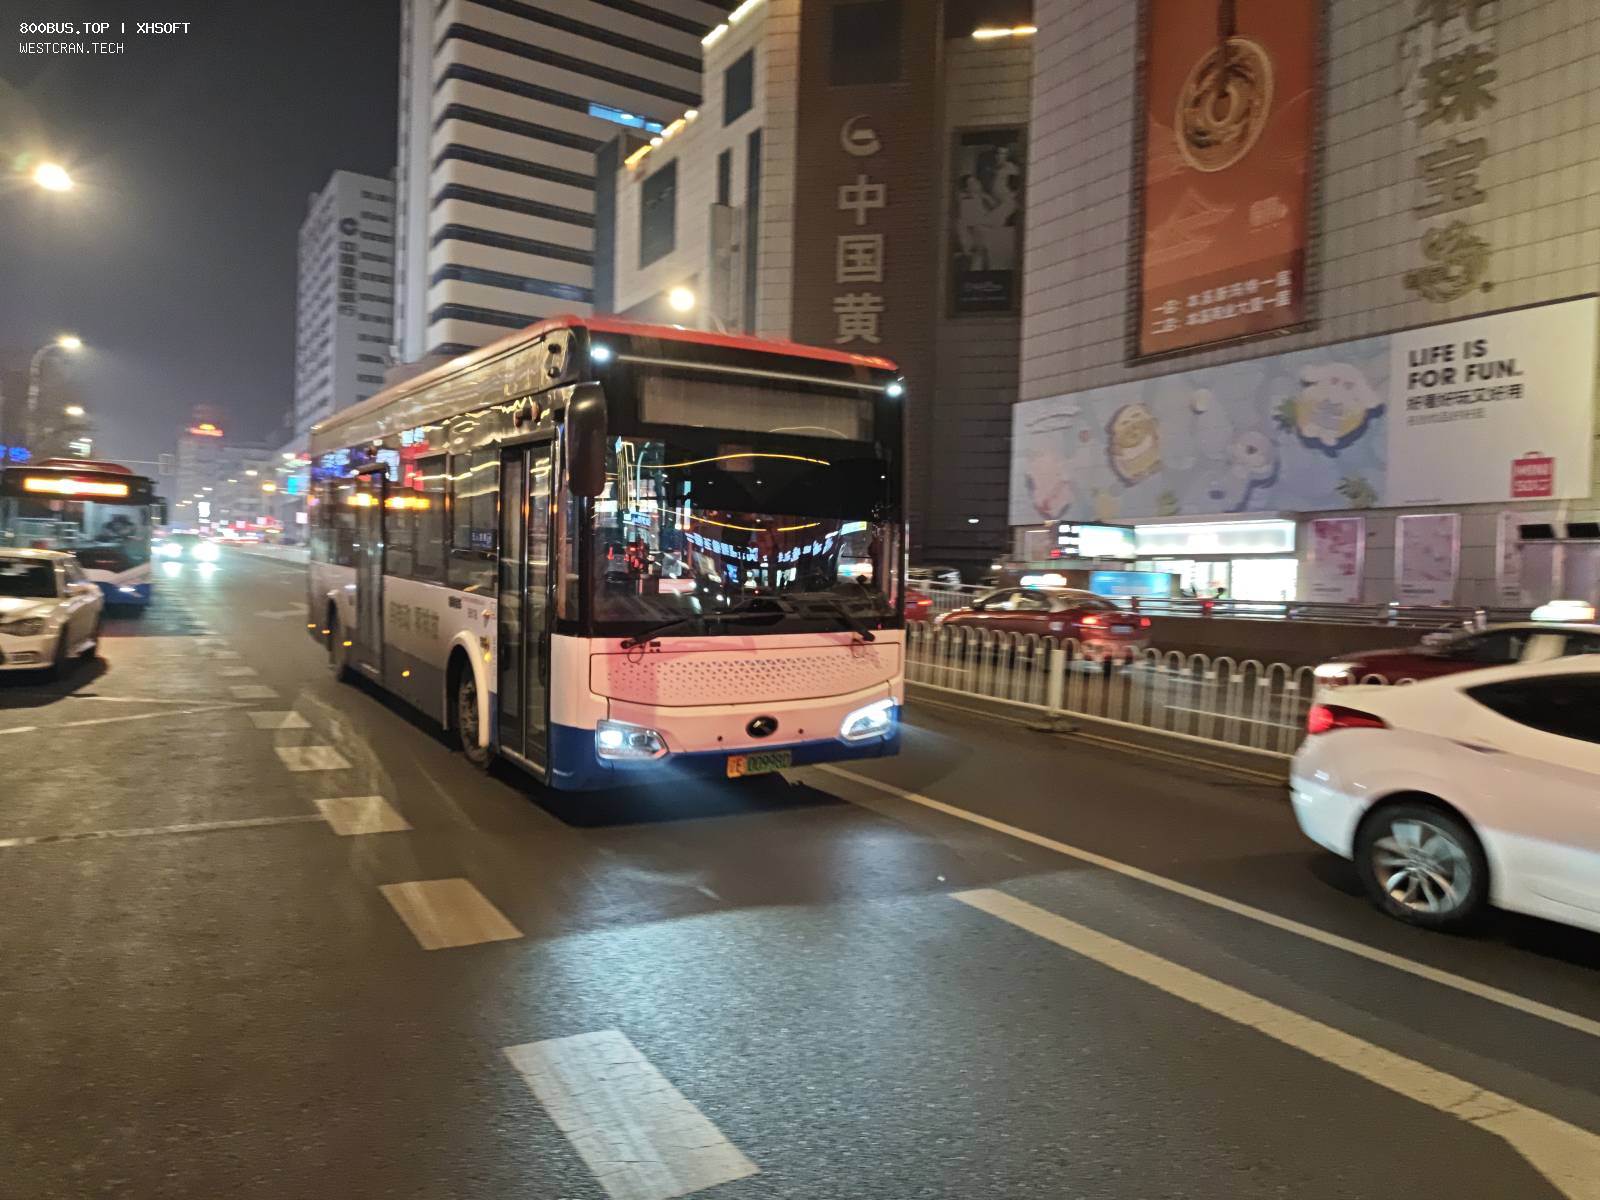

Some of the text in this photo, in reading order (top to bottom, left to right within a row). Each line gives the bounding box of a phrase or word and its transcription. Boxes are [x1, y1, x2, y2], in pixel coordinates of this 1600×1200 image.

[1408, 338, 1488, 368] LIFE IS
[1407, 358, 1524, 391] FOR FUN.
